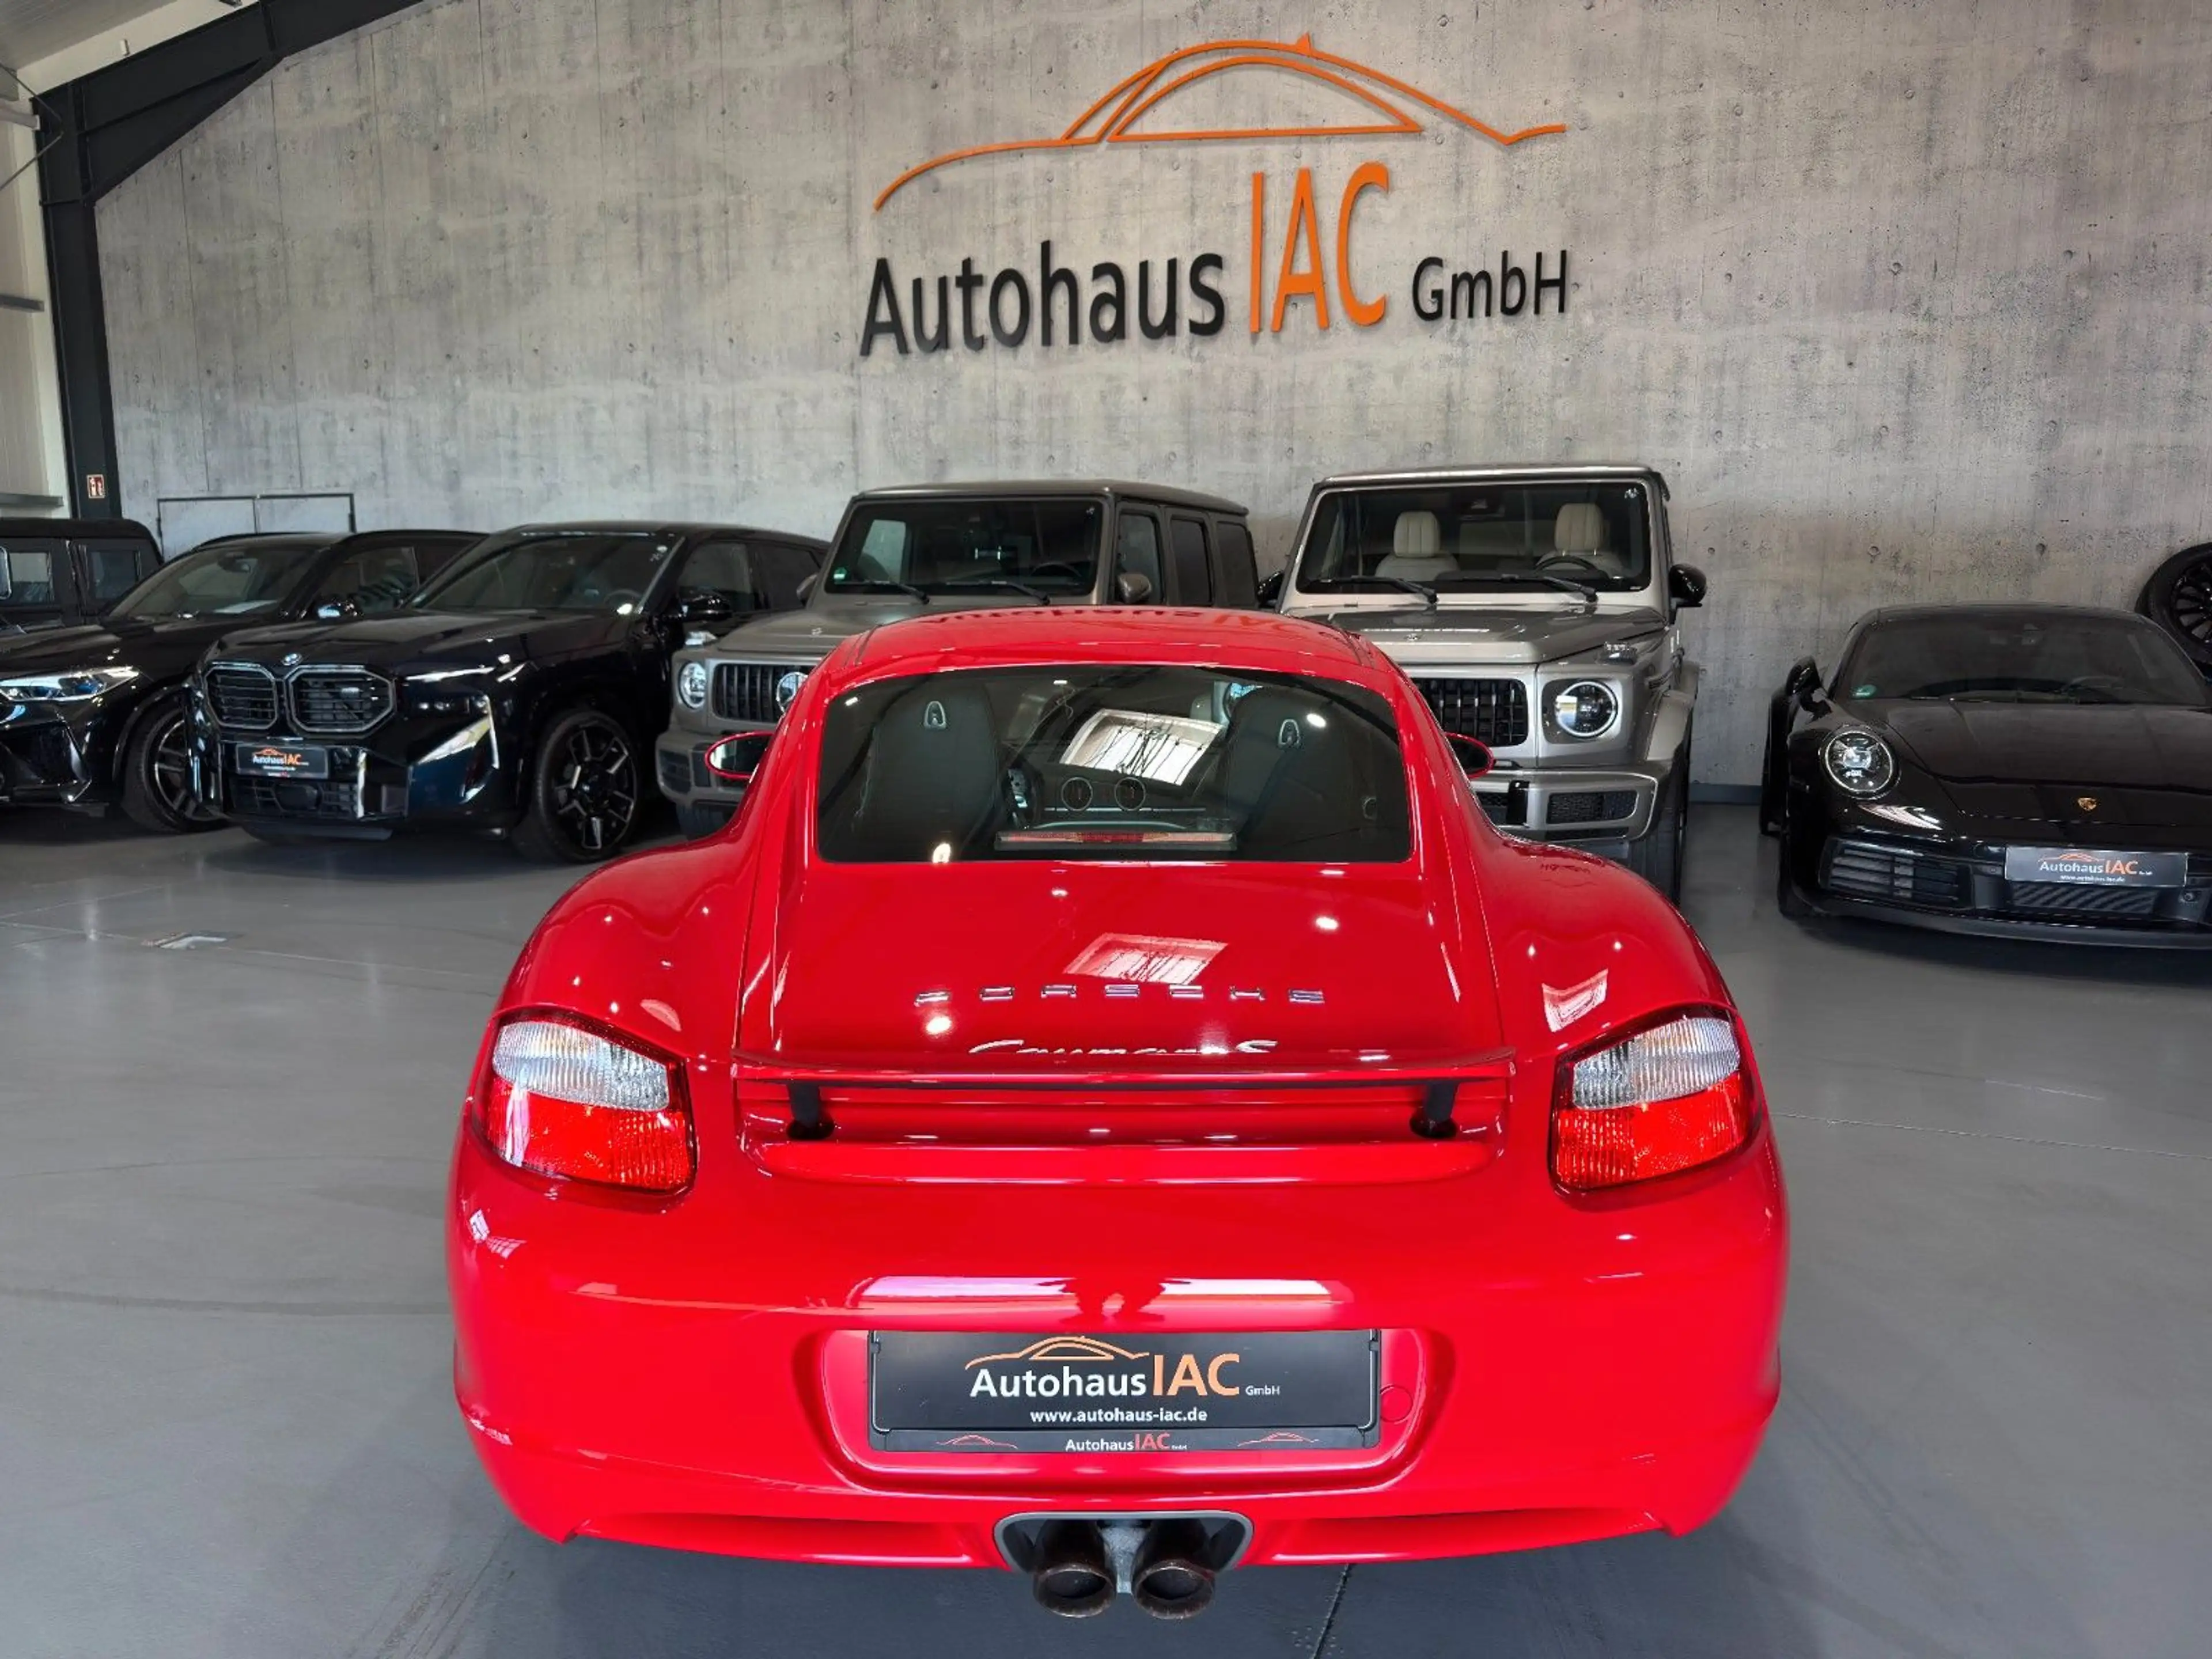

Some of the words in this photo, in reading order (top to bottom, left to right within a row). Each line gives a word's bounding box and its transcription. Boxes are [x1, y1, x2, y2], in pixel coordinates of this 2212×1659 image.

[860, 240, 1225, 356] Autohaus
[1249, 162, 1389, 334] IAC
[1412, 250, 1568, 321] GmbH
[970, 1366, 1147, 1397] Autohaus
[1153, 1353, 1240, 1396] IAC
[1245, 1385, 1281, 1396] GmbH
[1030, 1407, 1208, 1423] www.autohaus-iac.de
[1066, 1438, 1134, 1451] Autohaus
[1135, 1432, 1170, 1450] IAC
